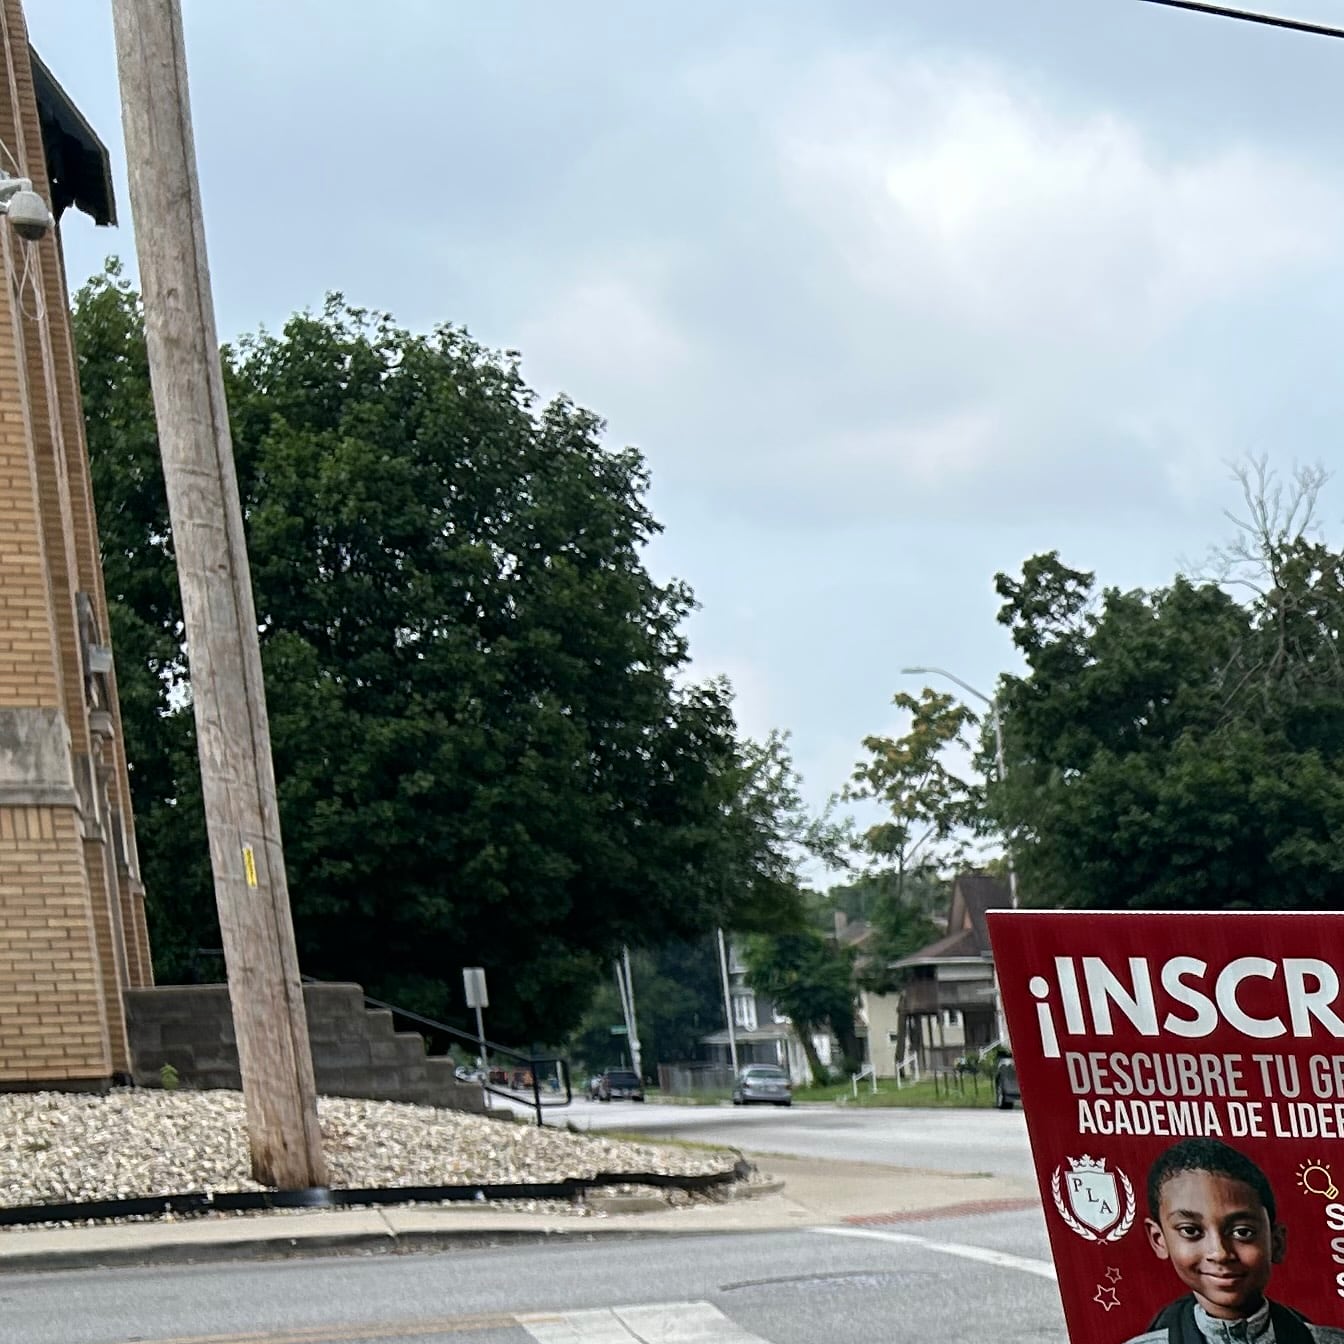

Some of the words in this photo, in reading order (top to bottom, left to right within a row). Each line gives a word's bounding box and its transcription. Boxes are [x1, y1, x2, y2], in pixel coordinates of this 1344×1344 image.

[1066, 1052, 1248, 1098] DESCUBRE
[1252, 1055, 1302, 1098] TU
[1078, 1100, 1223, 1136] ACADEMIA
[1227, 1102, 1267, 1138] DE
